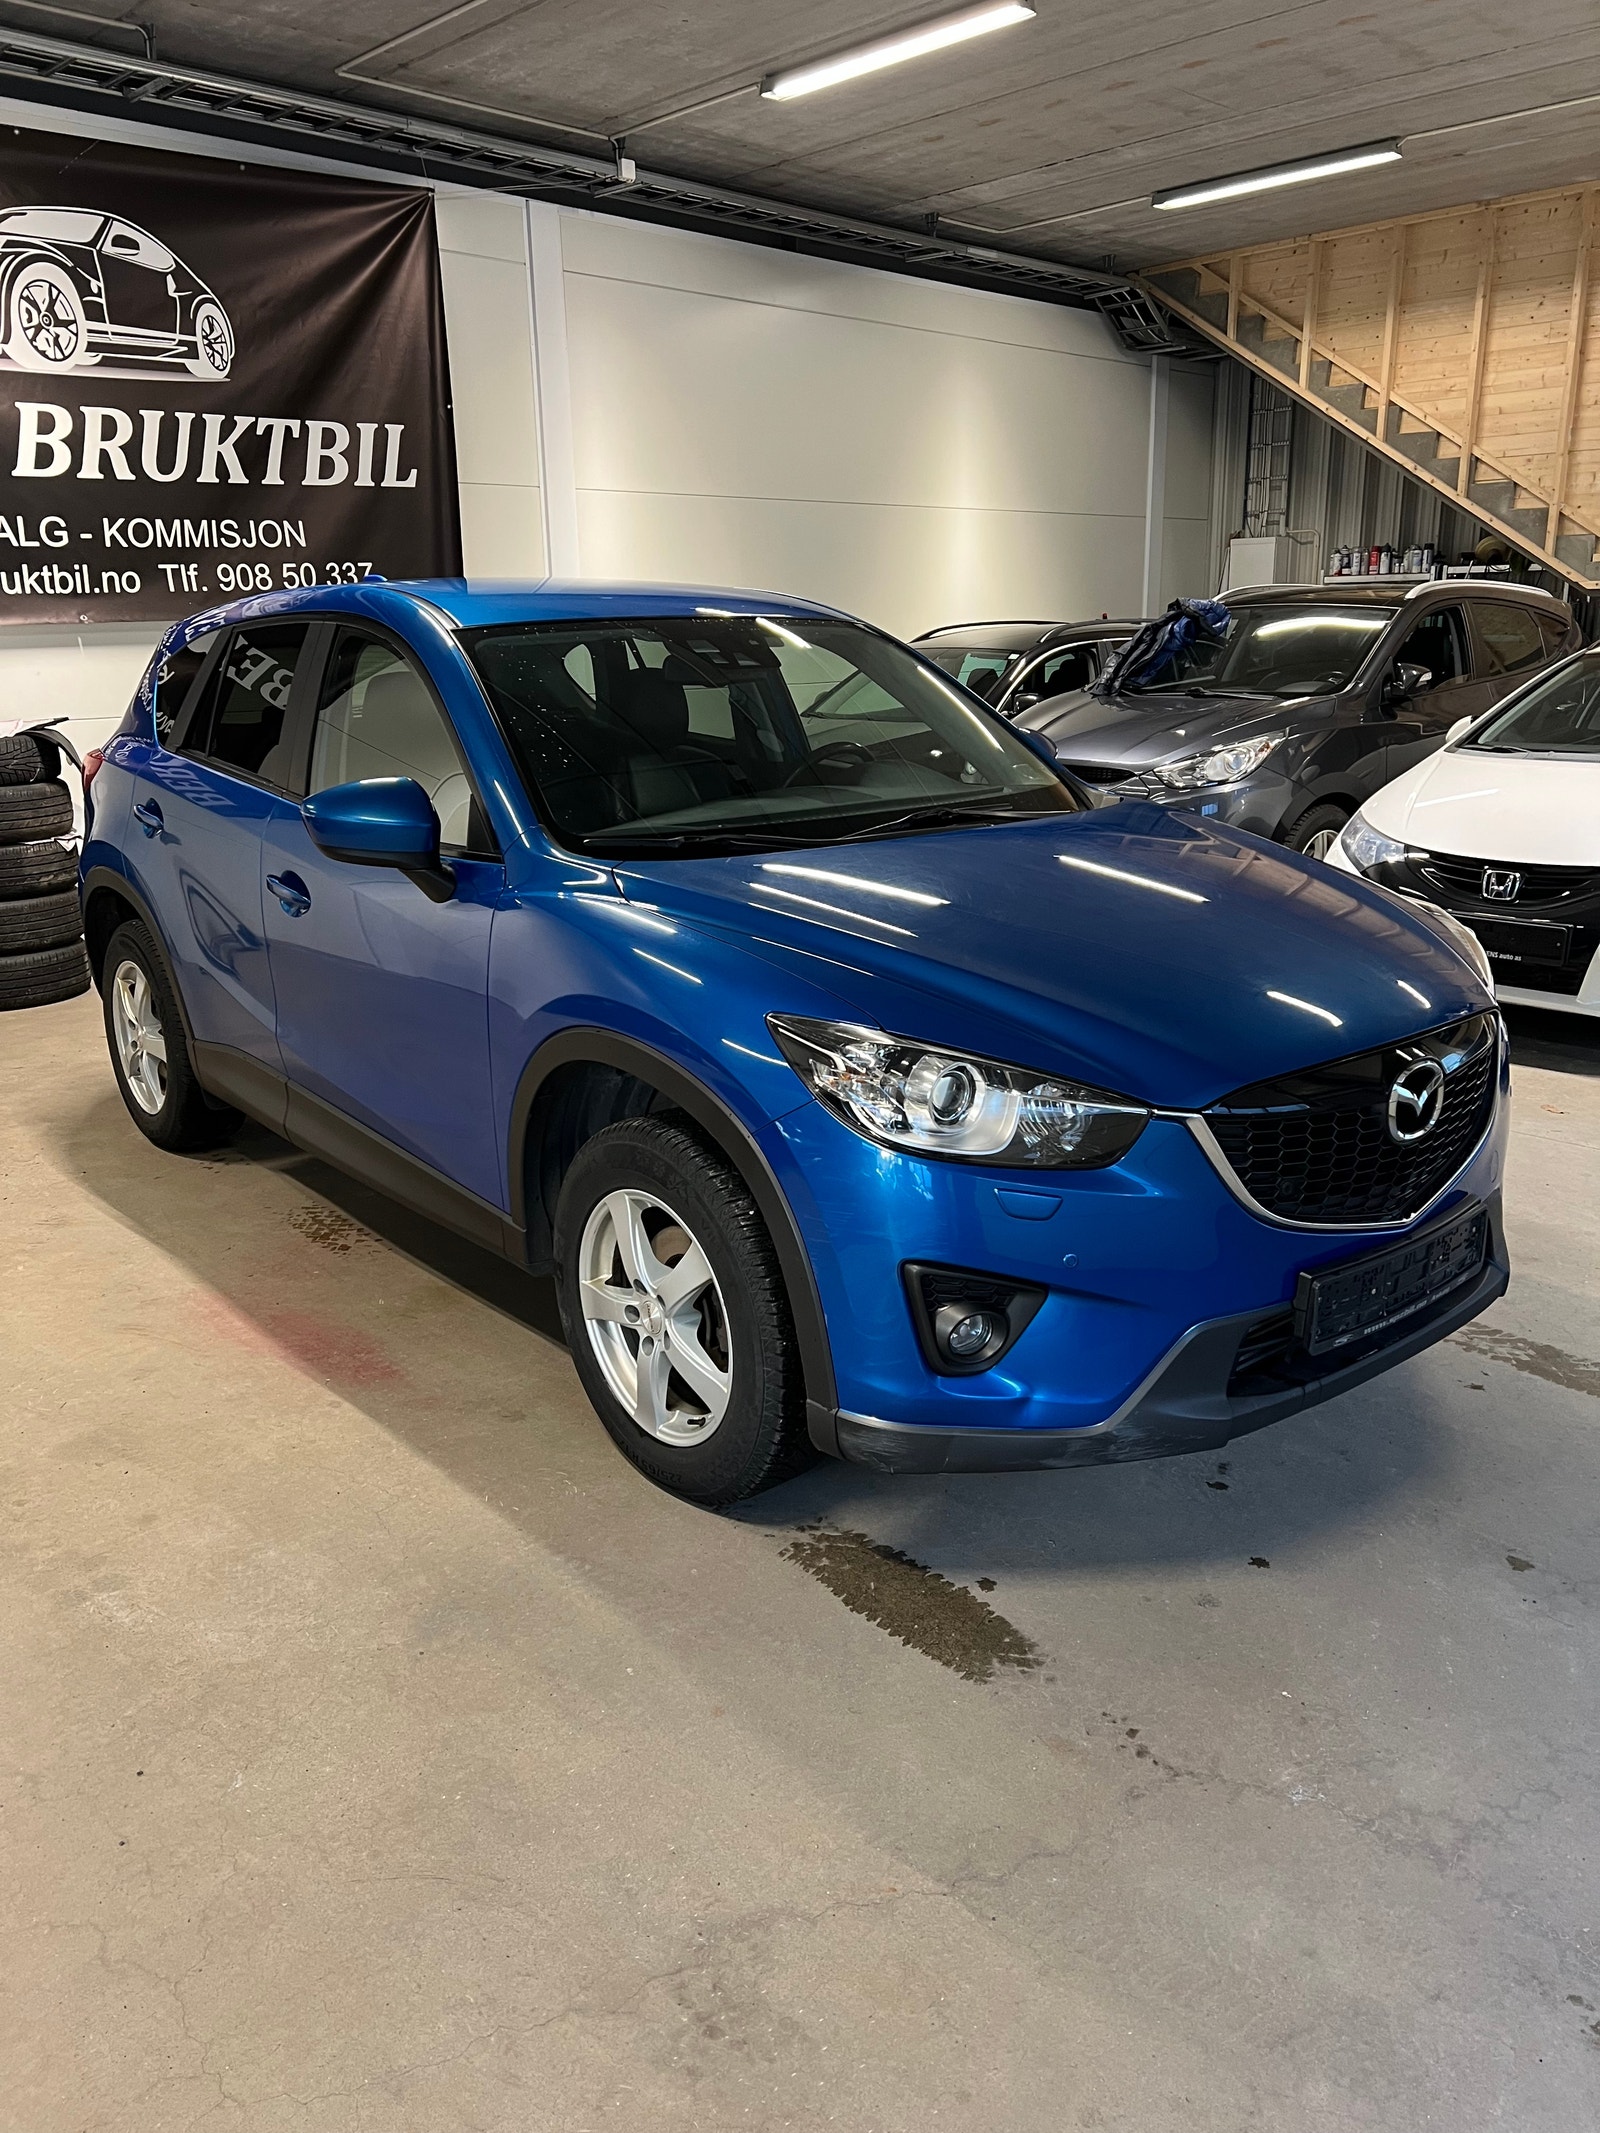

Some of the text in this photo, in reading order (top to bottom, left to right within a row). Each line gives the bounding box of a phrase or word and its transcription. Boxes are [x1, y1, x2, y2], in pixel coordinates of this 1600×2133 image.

[11, 401, 419, 488] BRUKTBIL
[0, 515, 307, 548] ALG - KOMMISJON
[0, 563, 141, 595] uktbil.no
[158, 563, 208, 592] Tlf.
[216, 562, 273, 591] 908
[282, 562, 317, 590] 50
[1499, 952, 1514, 961] auto
